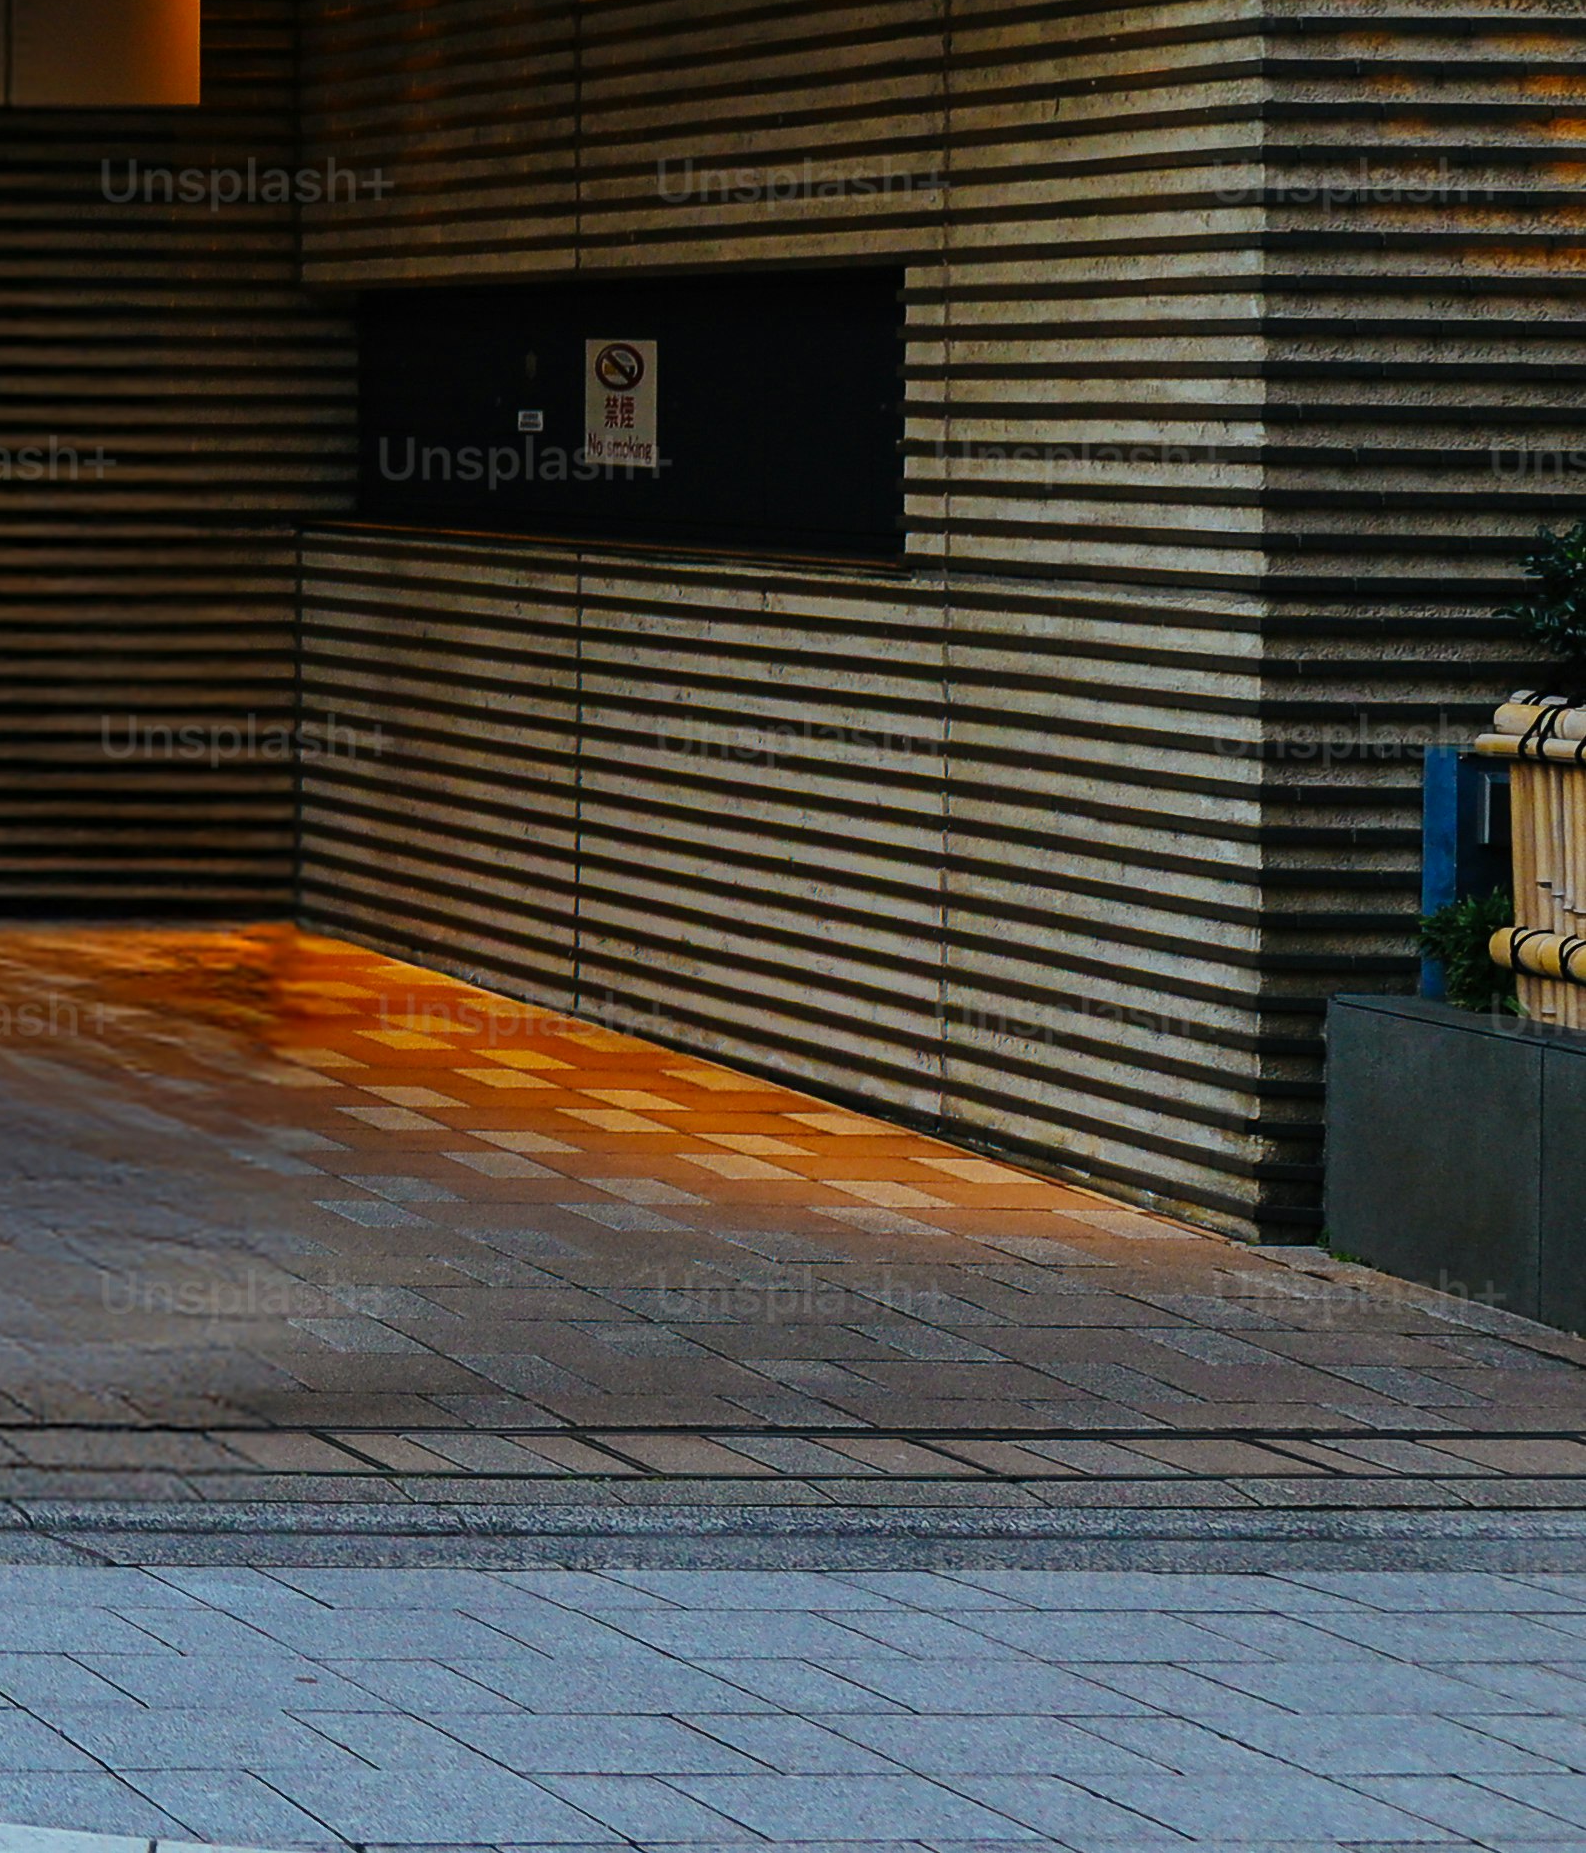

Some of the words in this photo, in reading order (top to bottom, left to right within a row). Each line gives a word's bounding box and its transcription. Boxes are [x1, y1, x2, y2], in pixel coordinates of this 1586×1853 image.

[604, 394, 635, 429] 禁煙
[587, 432, 603, 457] No
[606, 434, 653, 465] smoking
